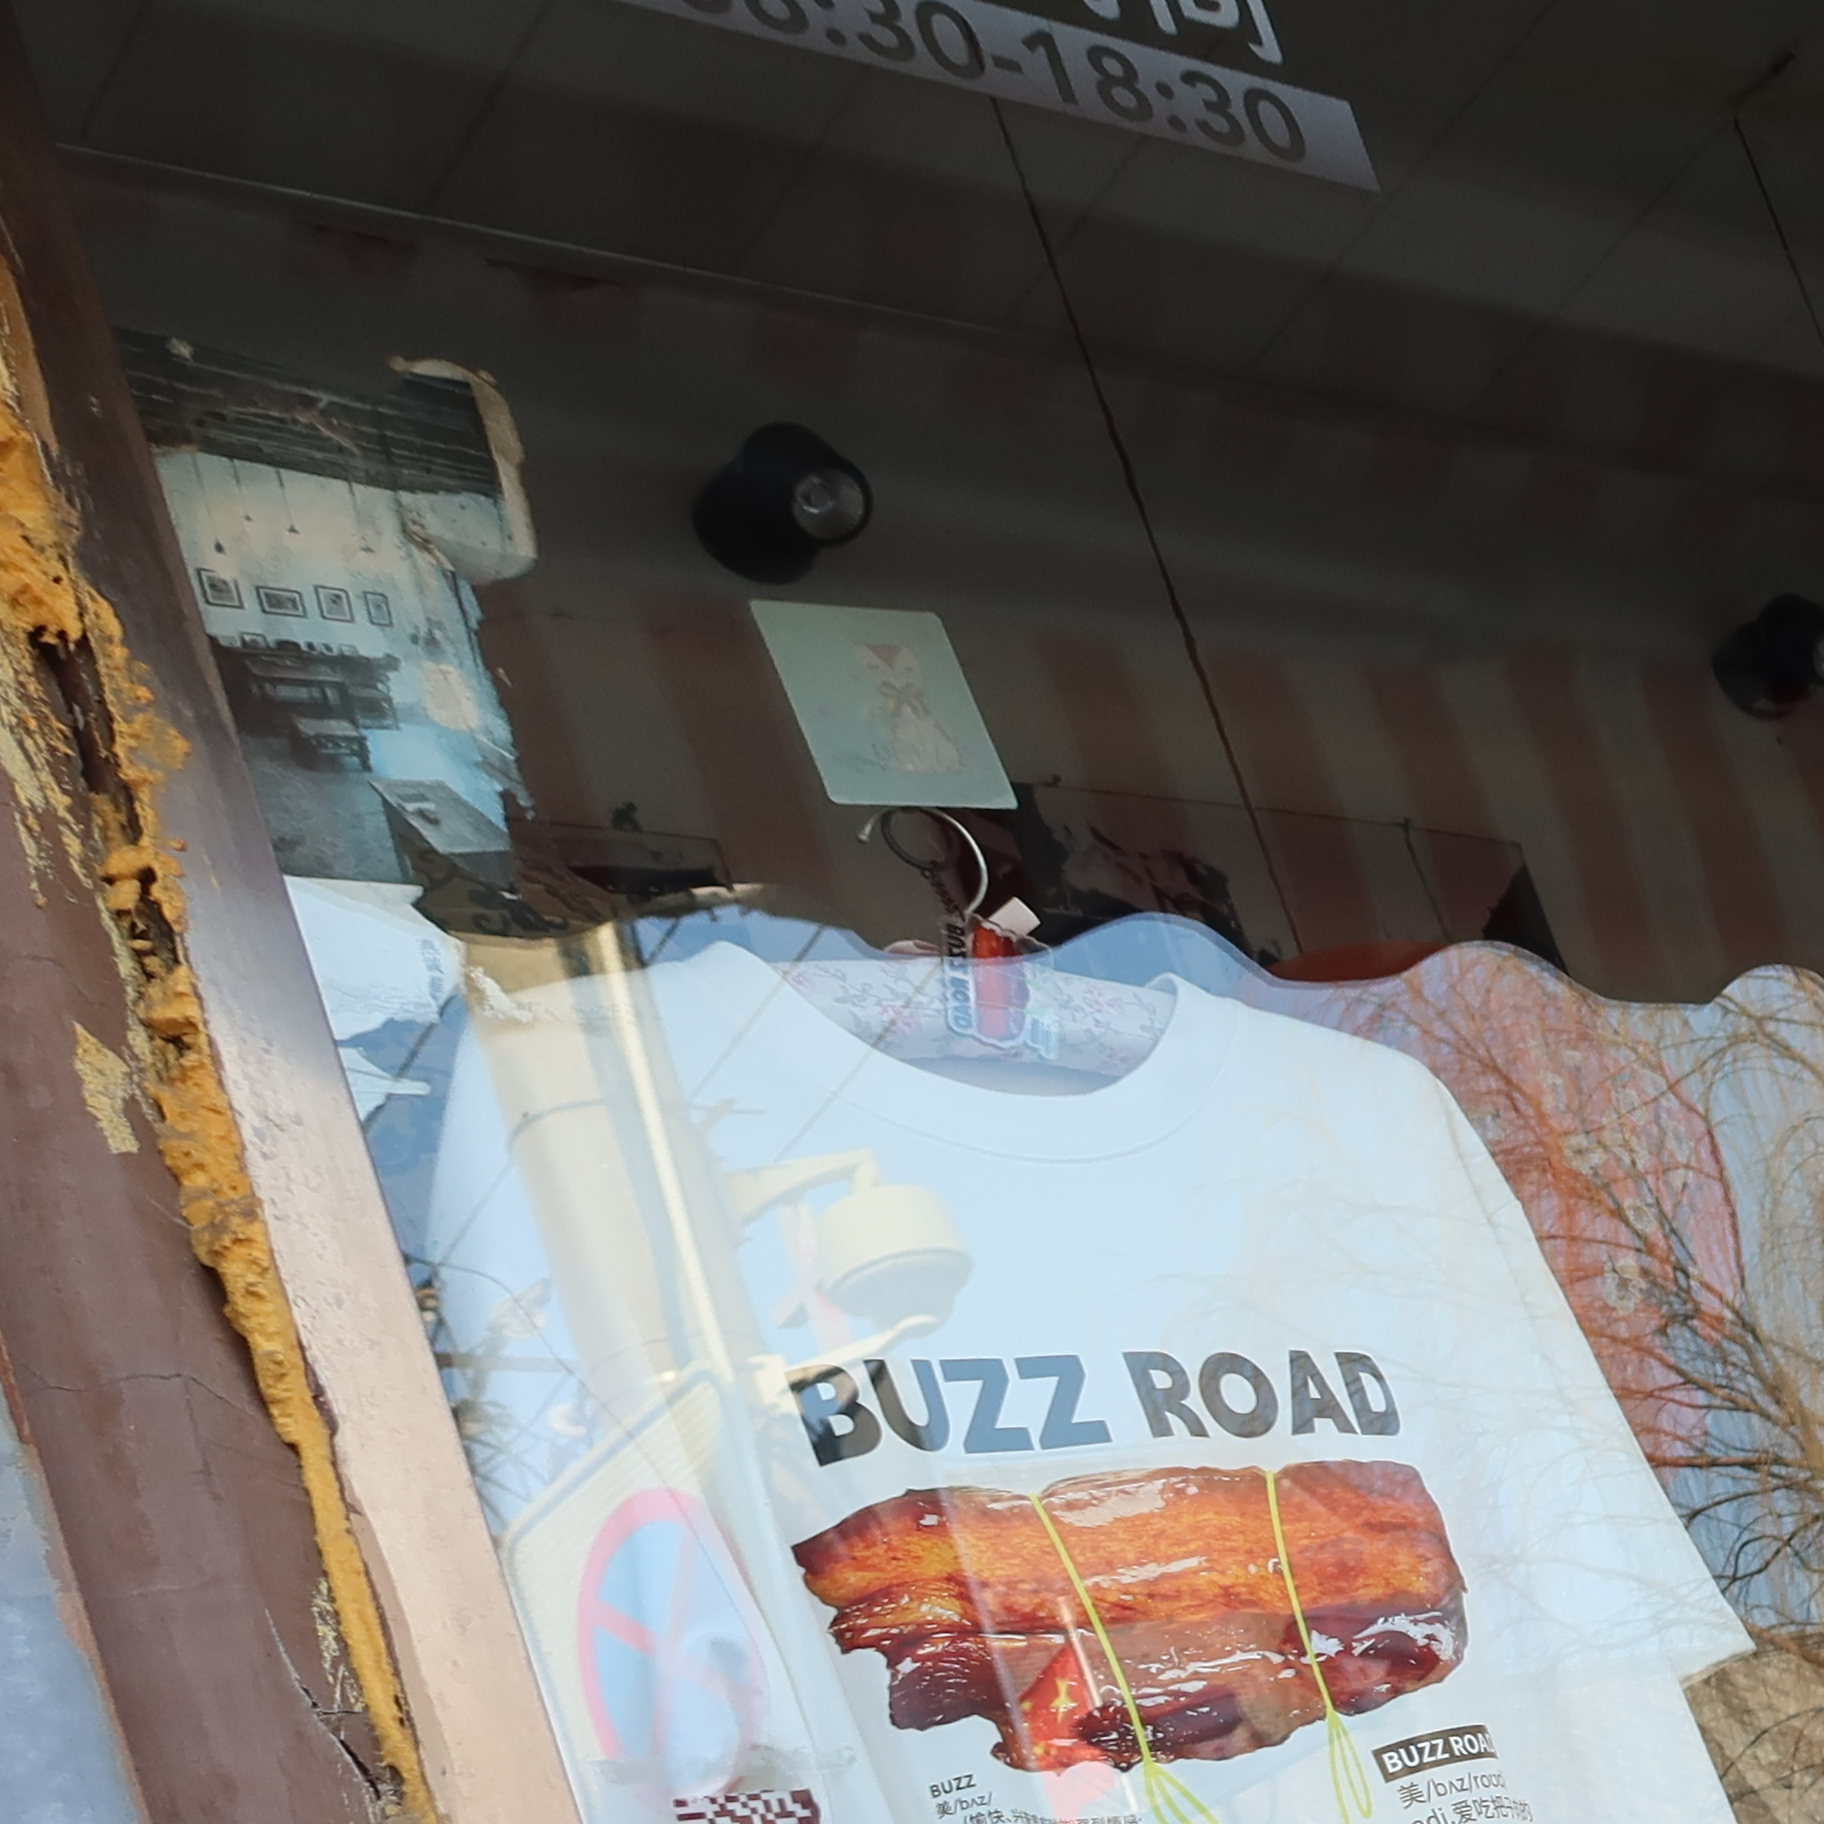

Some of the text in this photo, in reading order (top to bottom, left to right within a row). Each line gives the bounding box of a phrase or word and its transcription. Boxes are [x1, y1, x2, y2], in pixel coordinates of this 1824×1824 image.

[785, 1349, 1402, 1467] BUZZ ROAD
[1382, 1739, 1450, 1774] BUZZ
[929, 1774, 976, 1799] BUZZ
